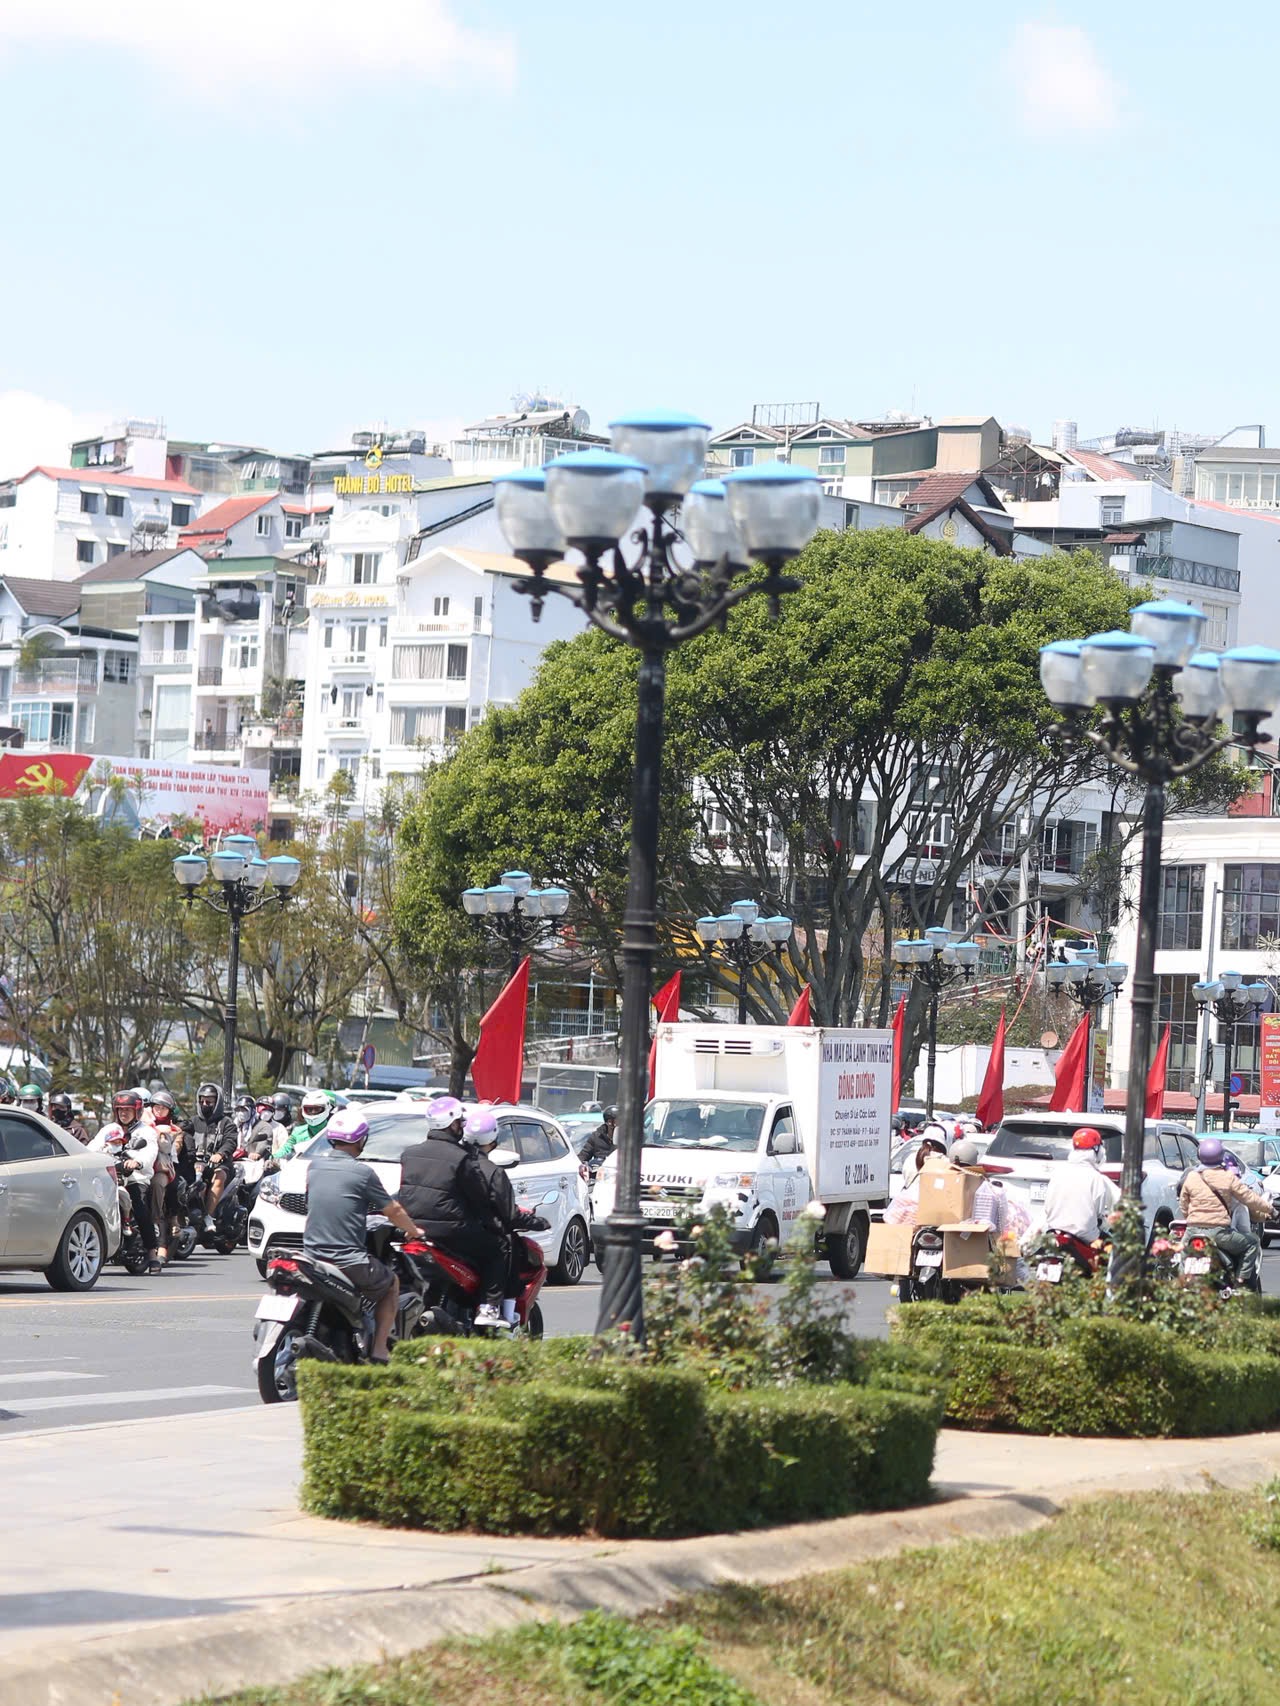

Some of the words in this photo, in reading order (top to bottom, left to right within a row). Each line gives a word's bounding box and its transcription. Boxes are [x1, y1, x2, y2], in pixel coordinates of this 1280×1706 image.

[384, 474, 413, 492] HOTEL
[838, 1070, 855, 1100] ĐÔNG
[855, 1071, 875, 1099] DƯƠNG
[639, 1174, 693, 1184] SUZUKI
